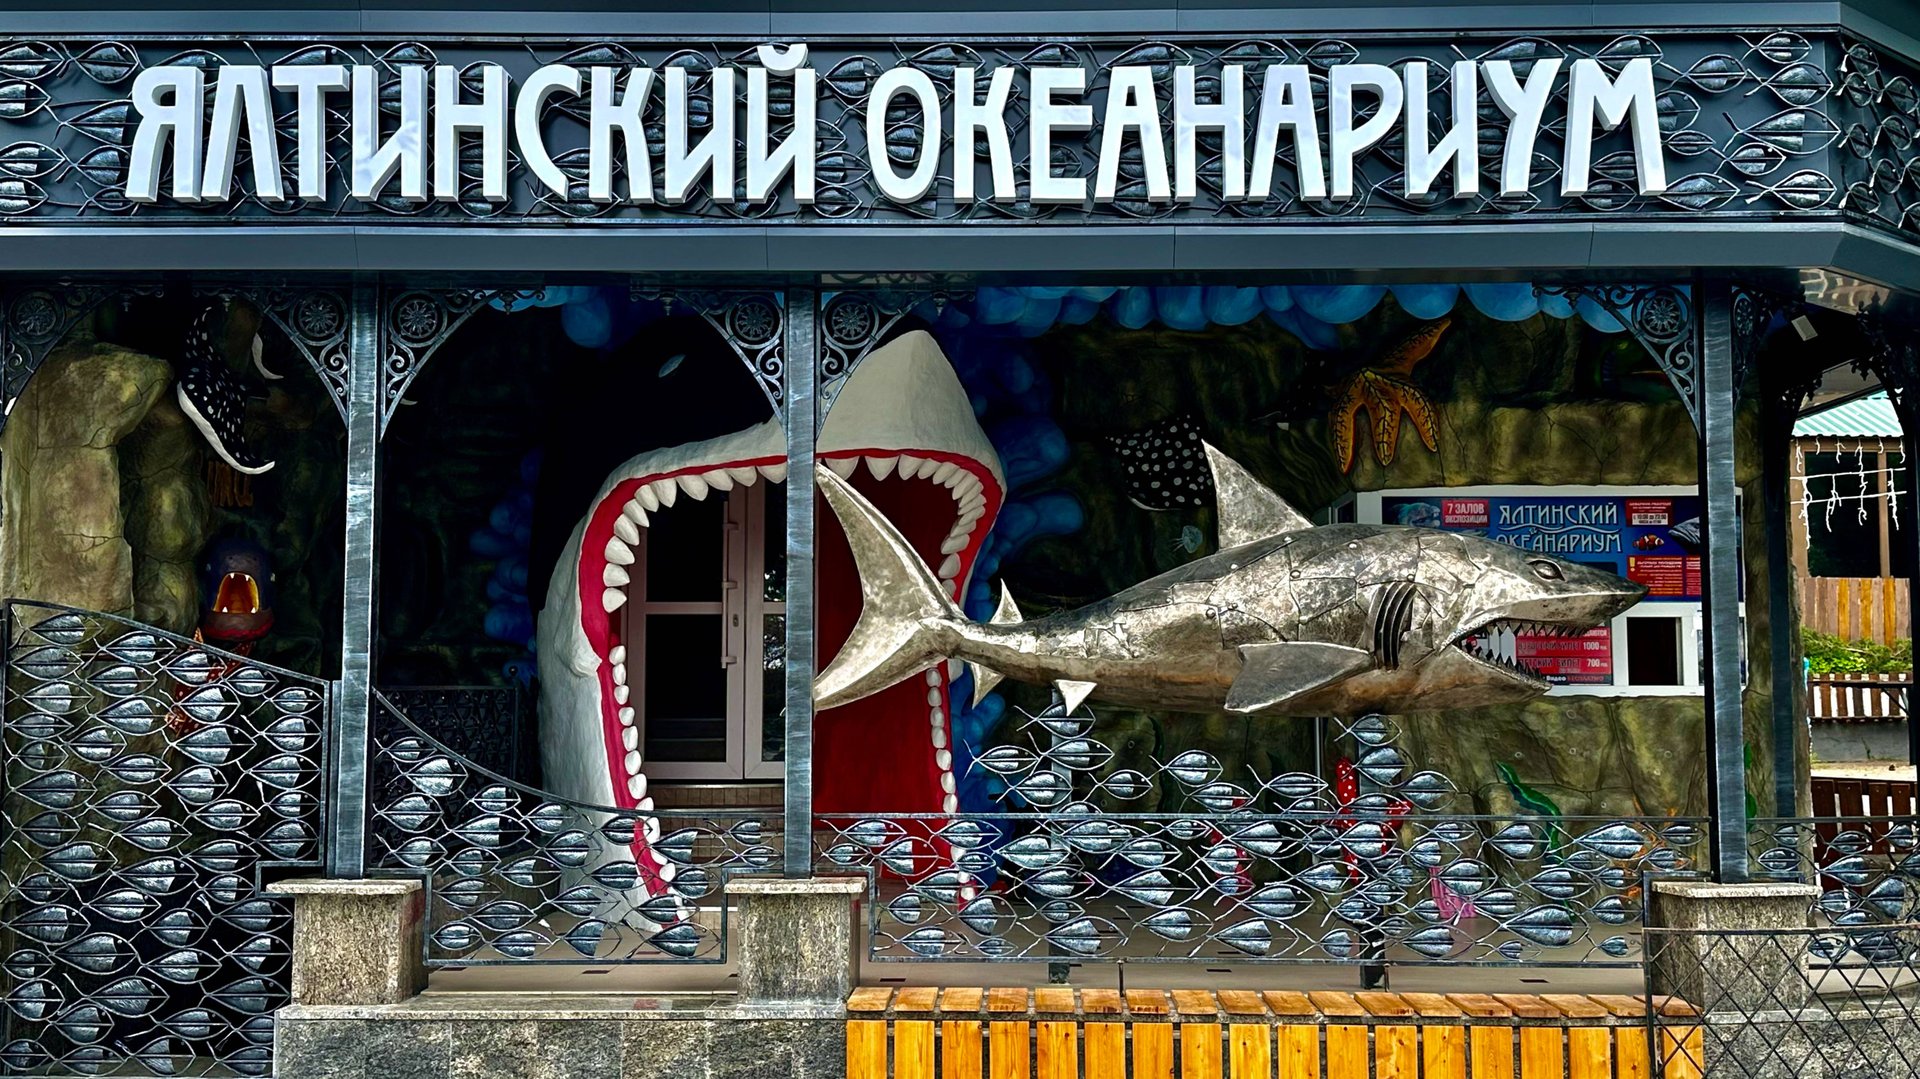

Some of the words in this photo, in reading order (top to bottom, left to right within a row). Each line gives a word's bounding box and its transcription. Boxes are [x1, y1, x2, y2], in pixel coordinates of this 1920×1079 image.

[125, 44, 817, 203] ЯЛТИНСКИЙ
[866, 56, 1667, 204] ОКЕАНАРИУМ
[1447, 503, 1453, 514] 7
[1454, 503, 1485, 514] ЗАЛОВ
[1499, 502, 1617, 524] ЯЛТИНСКИЙ
[1445, 514, 1488, 523] ЭКСПОЗИЦИИ
[1583, 641, 1600, 650] 1000
[1587, 658, 1600, 667] 700
